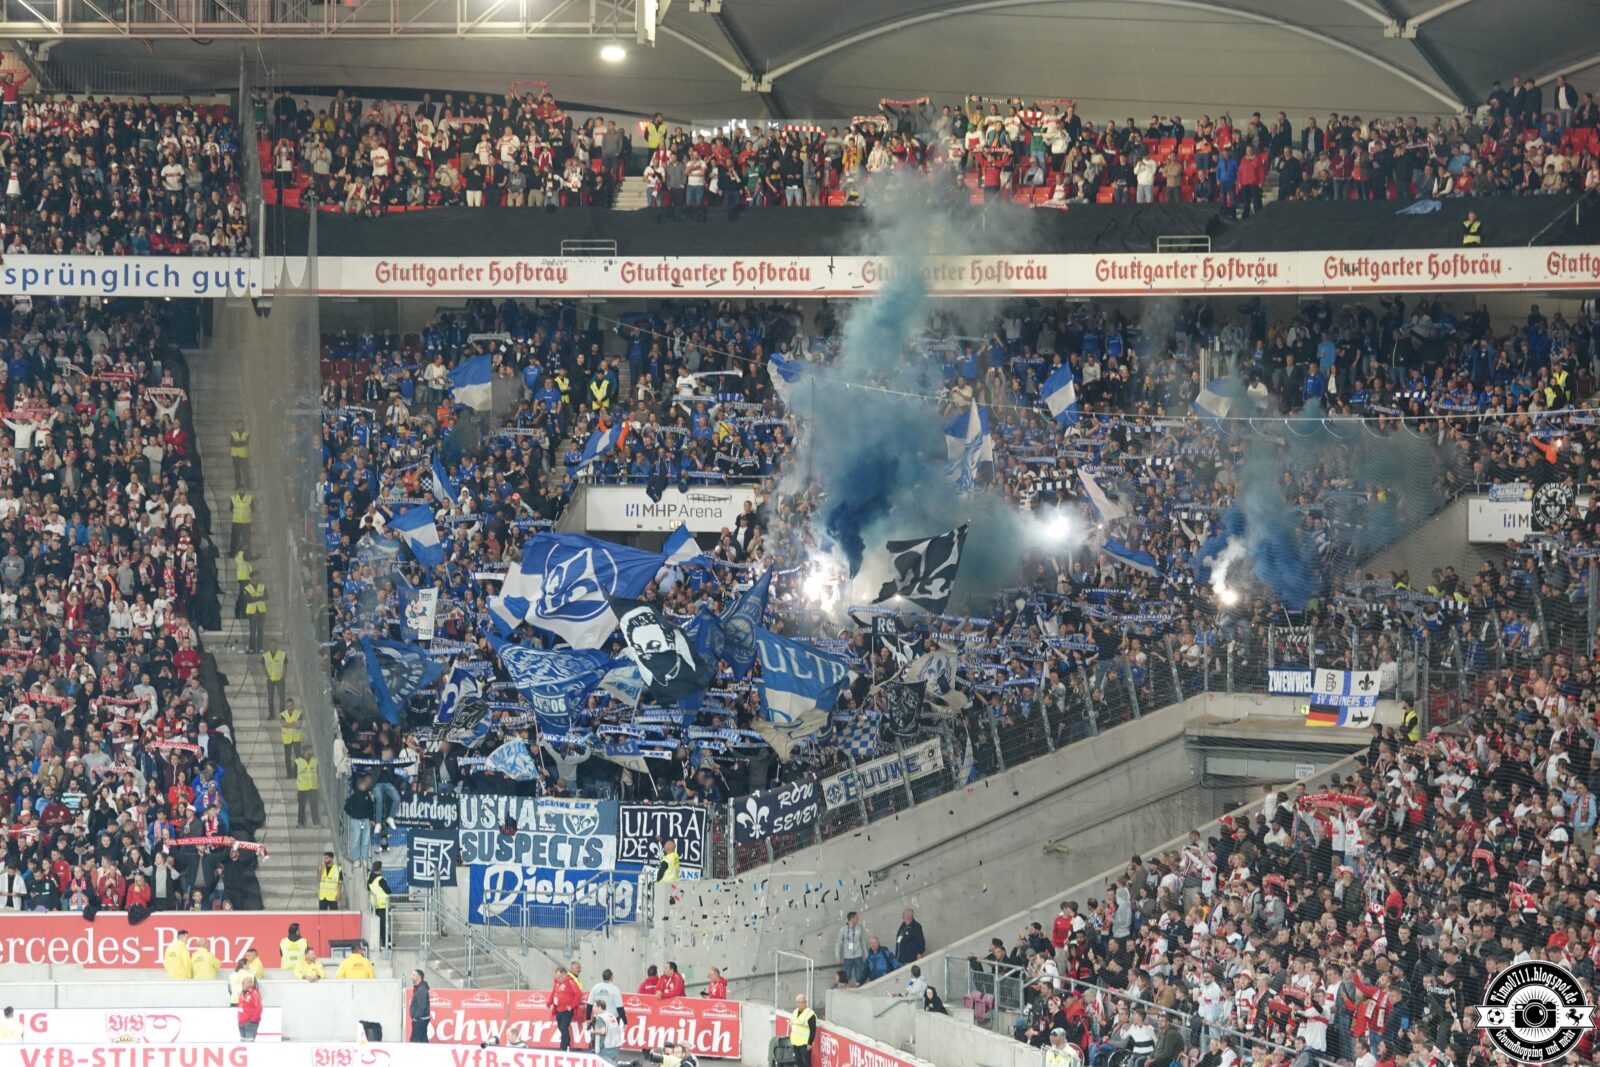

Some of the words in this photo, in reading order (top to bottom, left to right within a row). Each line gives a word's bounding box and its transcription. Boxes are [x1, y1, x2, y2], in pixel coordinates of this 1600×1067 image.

[4, 262, 180, 292] sprünglich
[192, 267, 257, 293] gut.
[375, 260, 484, 287] Stuttgarter
[620, 260, 727, 287] Stuttgarter
[732, 260, 811, 286] Hofbräu
[970, 259, 1048, 285] Hofbräu
[1095, 258, 1198, 285] Stuttgarter
[1202, 256, 1278, 282] Hofbräu
[1324, 255, 1423, 283] Stuttgarter
[1428, 252, 1502, 281] Hofbräu
[642, 503, 677, 518] MHP
[679, 504, 722, 518] Arena
[623, 811, 701, 840] ULTRA
[461, 831, 603, 868] SUSPECTS
[0, 927, 256, 965] rcedes-Benz
[20, 1047, 249, 1067] VfB-STIFTUNG
